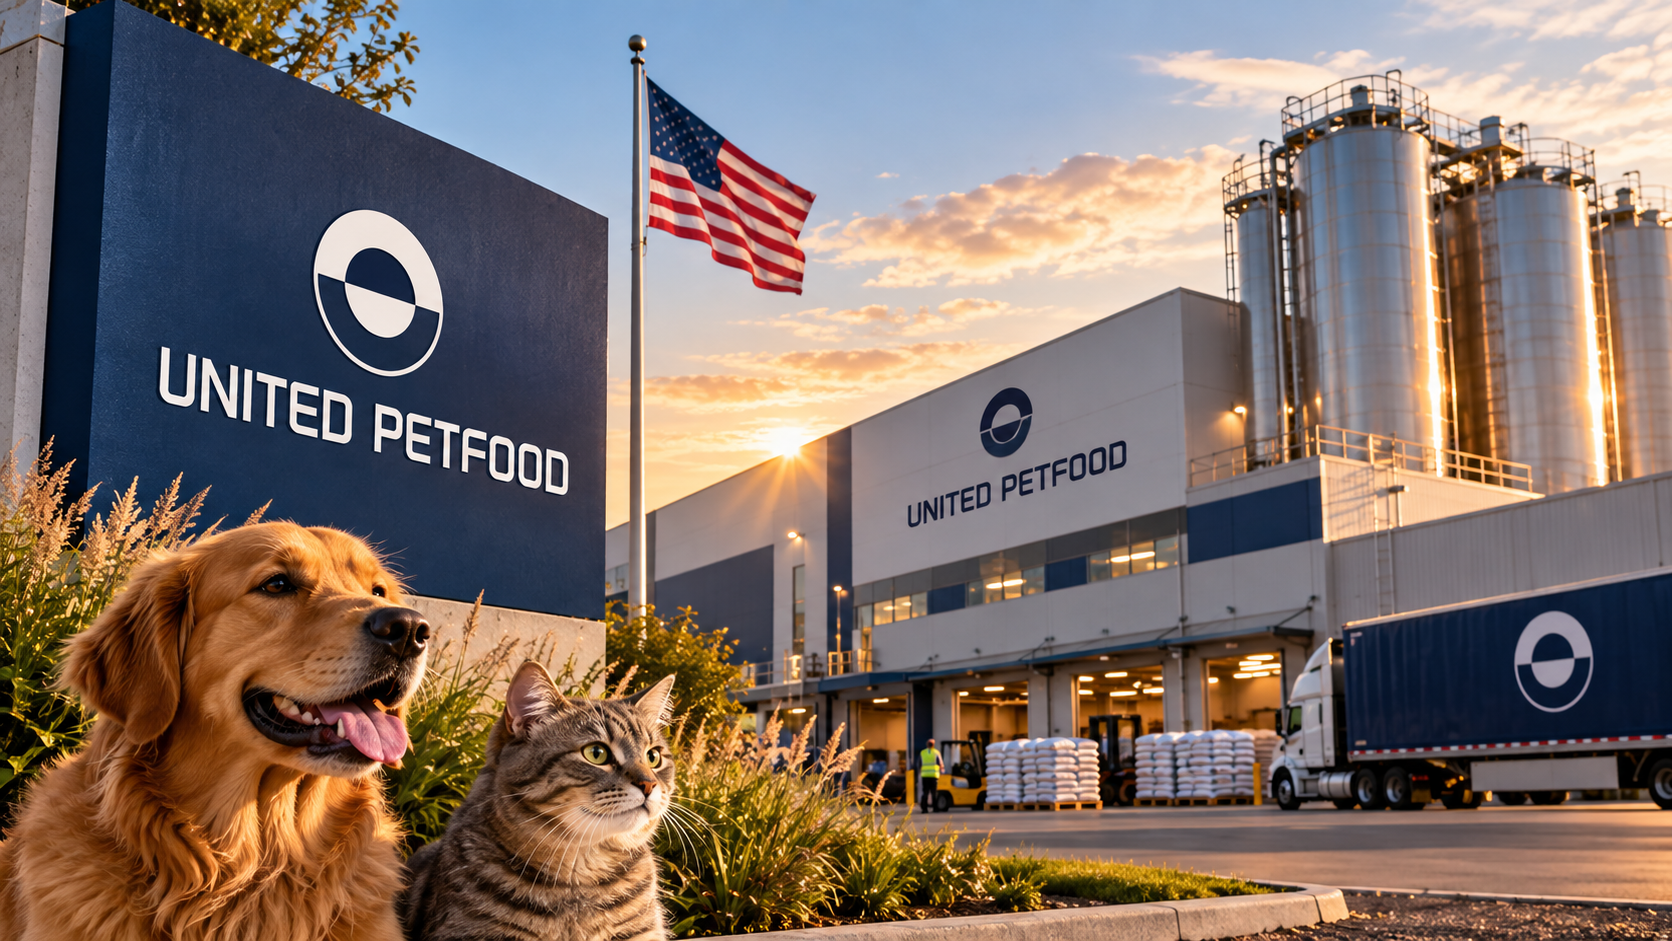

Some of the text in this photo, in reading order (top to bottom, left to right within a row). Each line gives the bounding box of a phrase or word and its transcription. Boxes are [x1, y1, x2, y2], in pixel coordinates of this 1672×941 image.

[158, 346, 569, 496] UNITED PETFOOD
[907, 440, 1127, 528] UNITED PETFOOD
